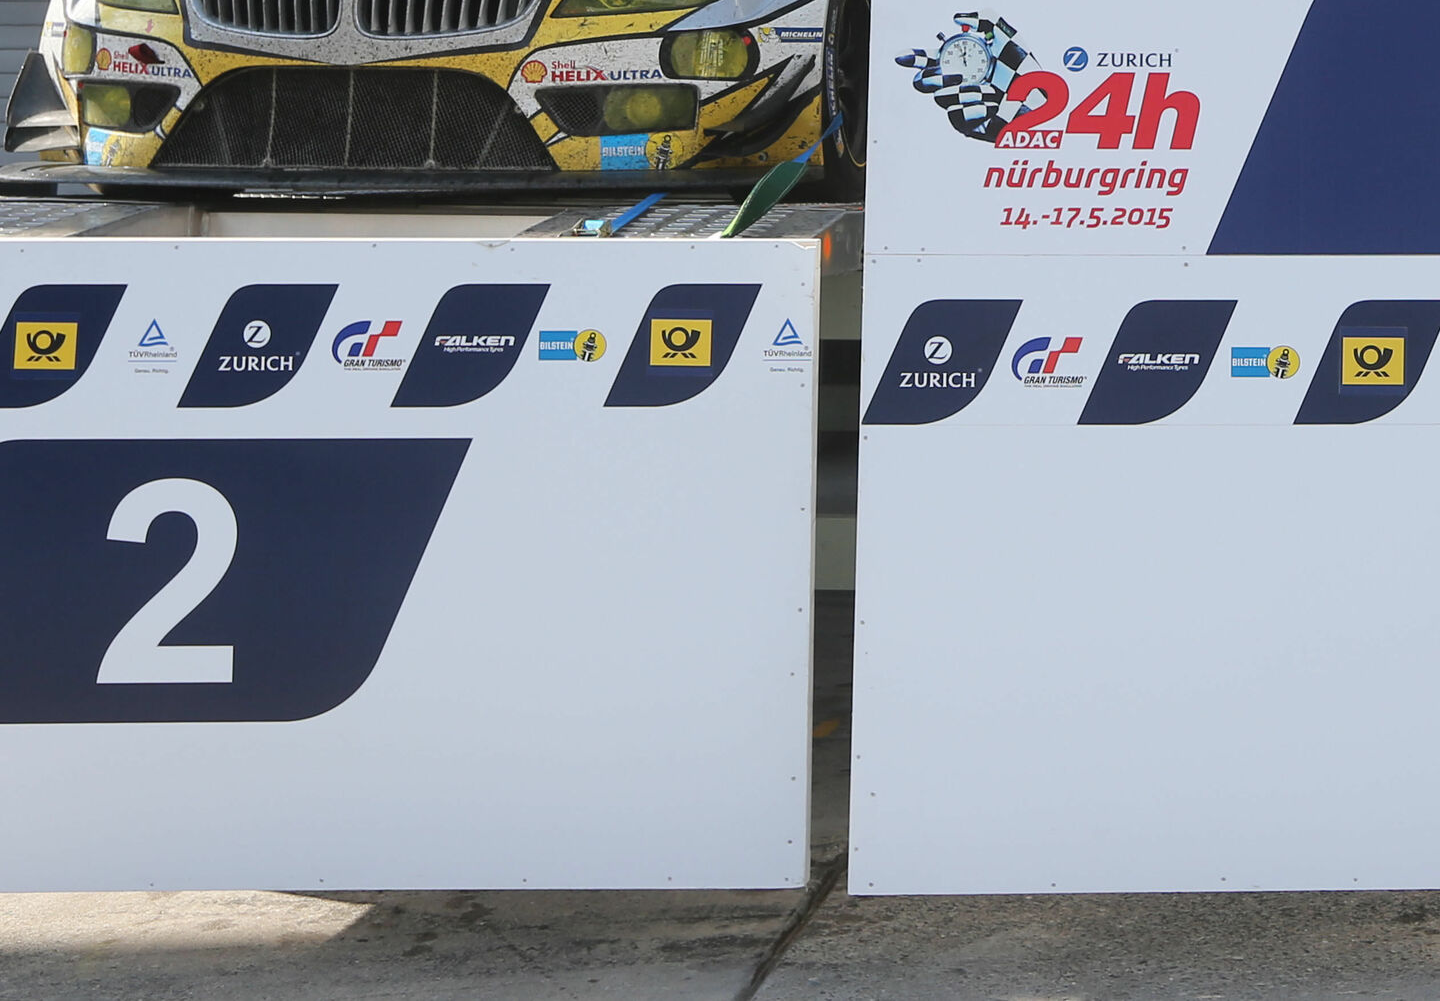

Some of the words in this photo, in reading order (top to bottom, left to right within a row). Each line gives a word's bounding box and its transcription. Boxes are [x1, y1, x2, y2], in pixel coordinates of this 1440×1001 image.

[780, 29, 823, 39] MICHELIN
[113, 51, 129, 60] Shell
[1097, 52, 1173, 68] ZURICH
[113, 62, 150, 75] HELIX
[151, 65, 193, 78] ULTRA
[551, 60, 577, 70] Shell
[551, 66, 609, 82] HELIX
[609, 69, 663, 80] ULTRA
[996, 71, 1200, 150] 24h
[999, 131, 1061, 148] ADAC
[602, 145, 645, 158] BILSTEIN
[983, 160, 1189, 196] nürburgring
[1000, 207, 1174, 229] 14.-17.5.2015
[435, 334, 516, 348] FALKEN
[540, 341, 574, 351] BILSTEIN
[218, 356, 294, 372] ZURICH
[343, 359, 367, 368] GRAN
[368, 359, 403, 368] TURISMO
[1117, 353, 1200, 365] FALKEN
[1232, 357, 1267, 367] BILSTEIN
[899, 373, 976, 388] ZURICH
[1024, 376, 1047, 385] GRAN
[1048, 376, 1084, 385] TURISMO
[96, 476, 239, 685] 2
